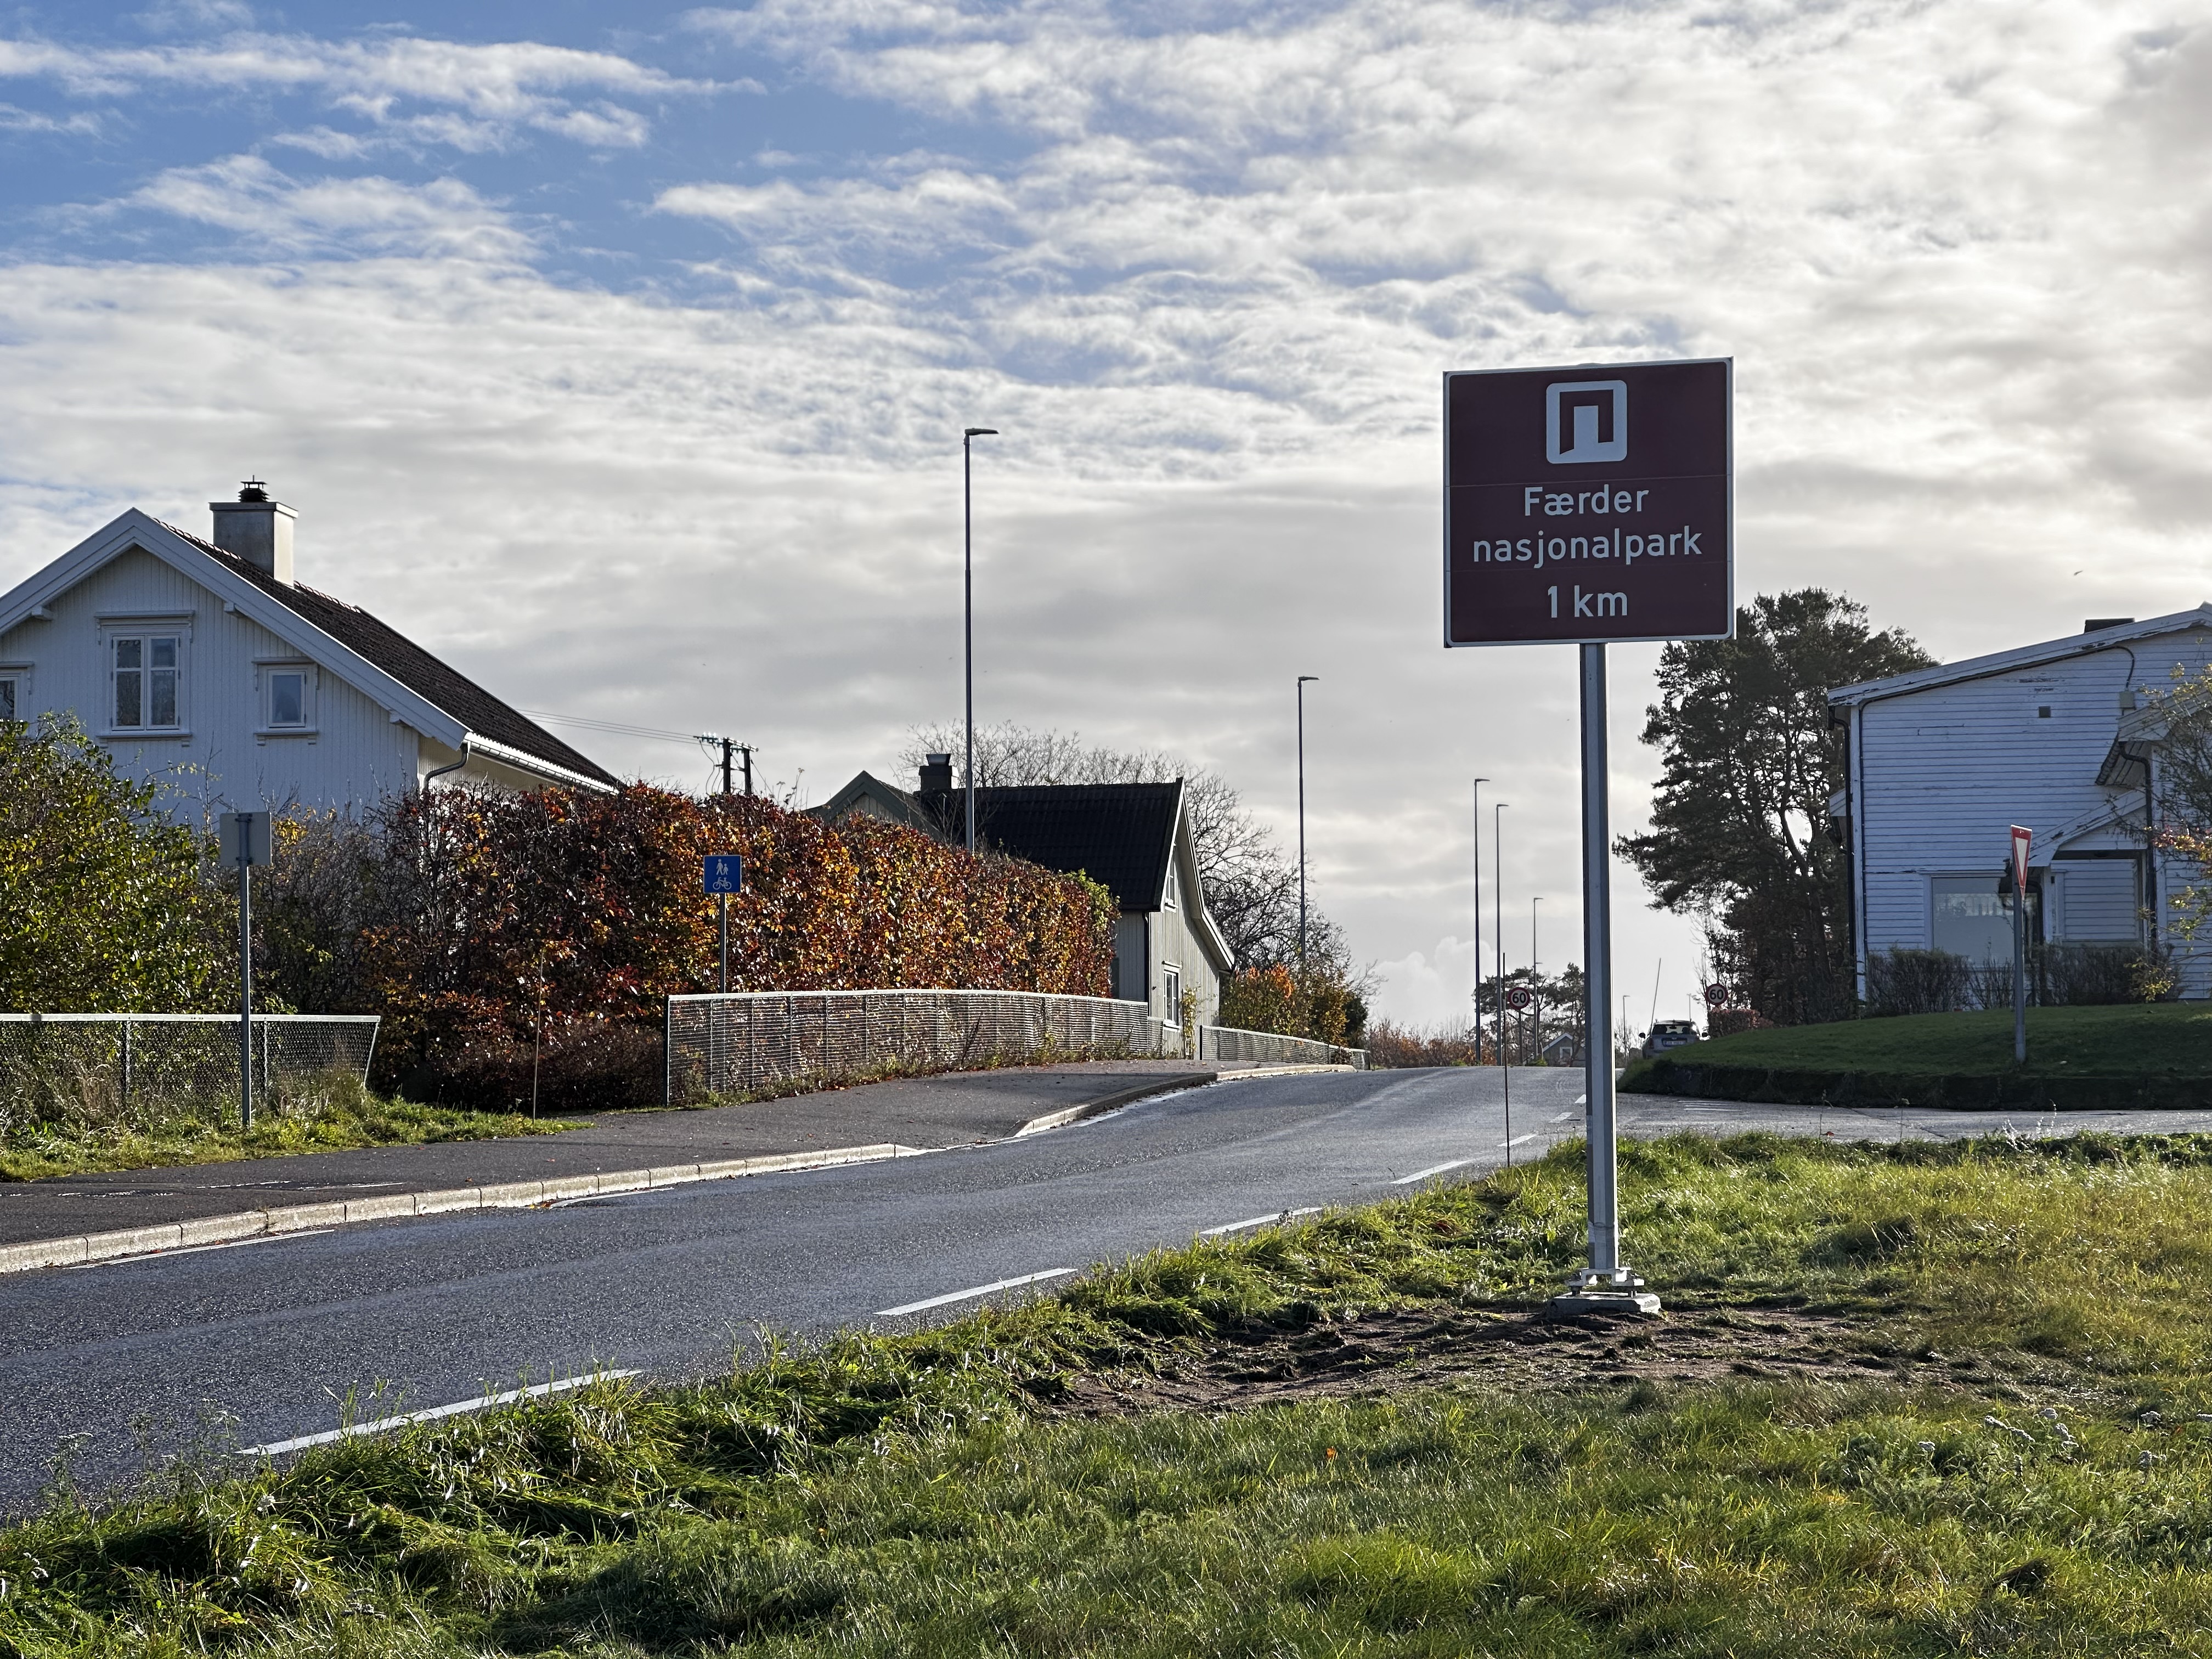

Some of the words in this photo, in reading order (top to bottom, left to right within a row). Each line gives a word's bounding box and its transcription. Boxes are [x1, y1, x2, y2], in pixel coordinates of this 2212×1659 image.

[1525, 484, 1649, 516] Færder
[1473, 525, 1702, 568] nasjonalpark
[1548, 585, 1558, 618] 1
[1574, 585, 1628, 618] km
[1513, 992, 1526, 1003] 60
[1709, 989, 1724, 1000] 60
